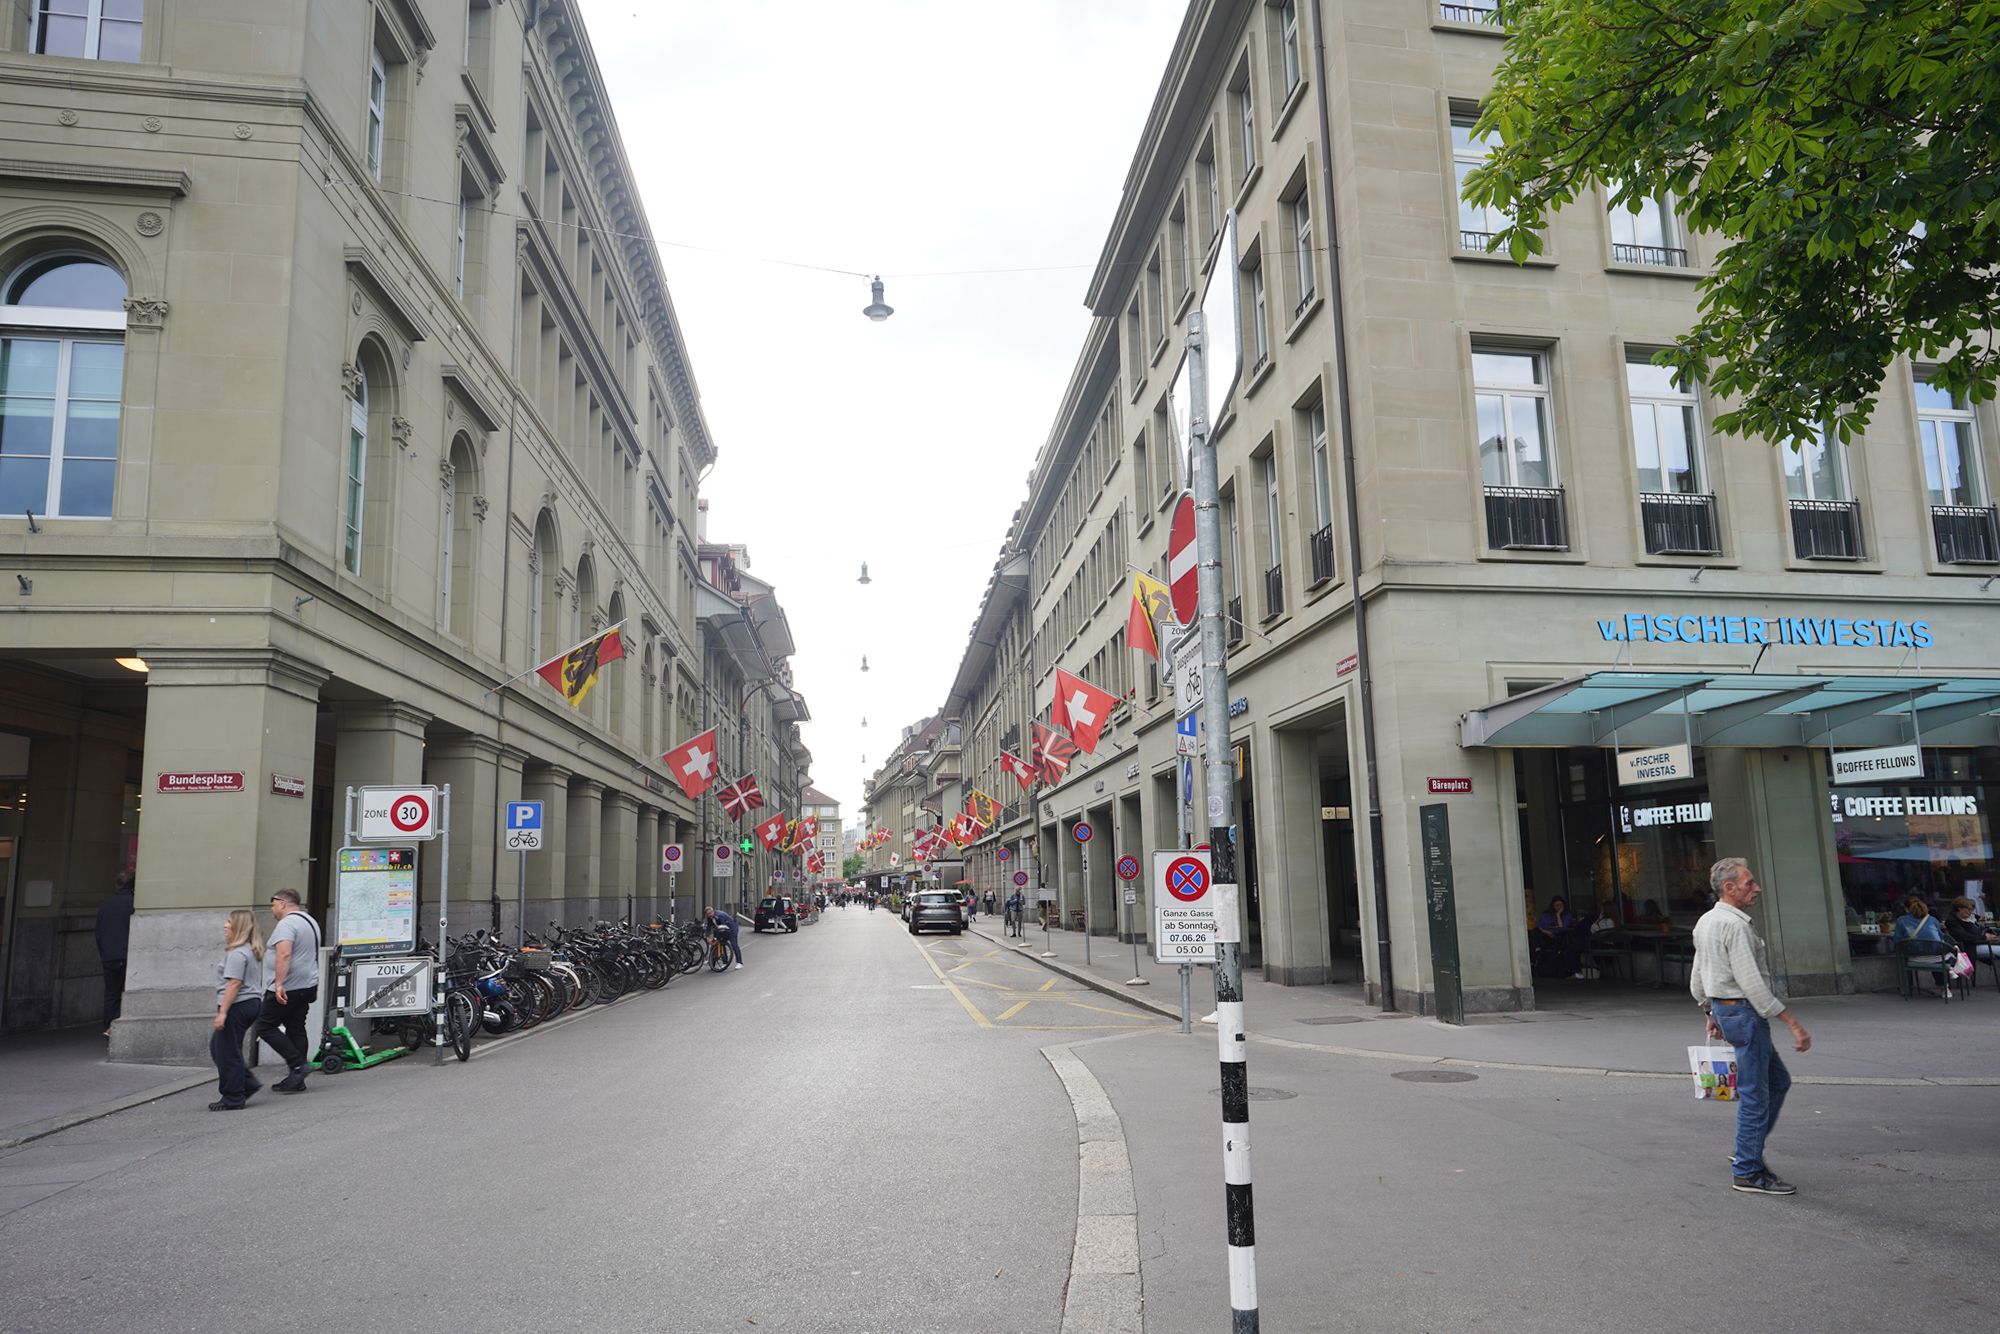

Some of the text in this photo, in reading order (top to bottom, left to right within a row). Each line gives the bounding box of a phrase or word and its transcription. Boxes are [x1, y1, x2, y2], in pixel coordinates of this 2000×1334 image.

[1597, 613, 1934, 648] v.FISCHER INVESTAS
[1630, 753, 1670, 767] v.FISCHER
[1843, 755, 1916, 774] COFFEE FELLOWS
[1637, 765, 1677, 779] INVESTAS
[169, 775, 233, 786] Bundesplatz
[1432, 780, 1468, 791] Bärenplatz
[1844, 796, 1977, 816] COFFEE FELLOWS
[364, 807, 417, 820] ZONE 30
[516, 806, 534, 826] P
[1633, 806, 1675, 827] COFFEE
[1165, 921, 1214, 931] ab Sonntag
[1170, 934, 1206, 942] 07.06.26
[1176, 946, 1204, 954] 05.00
[377, 965, 406, 975] ZONE
[407, 996, 415, 1004] 20
